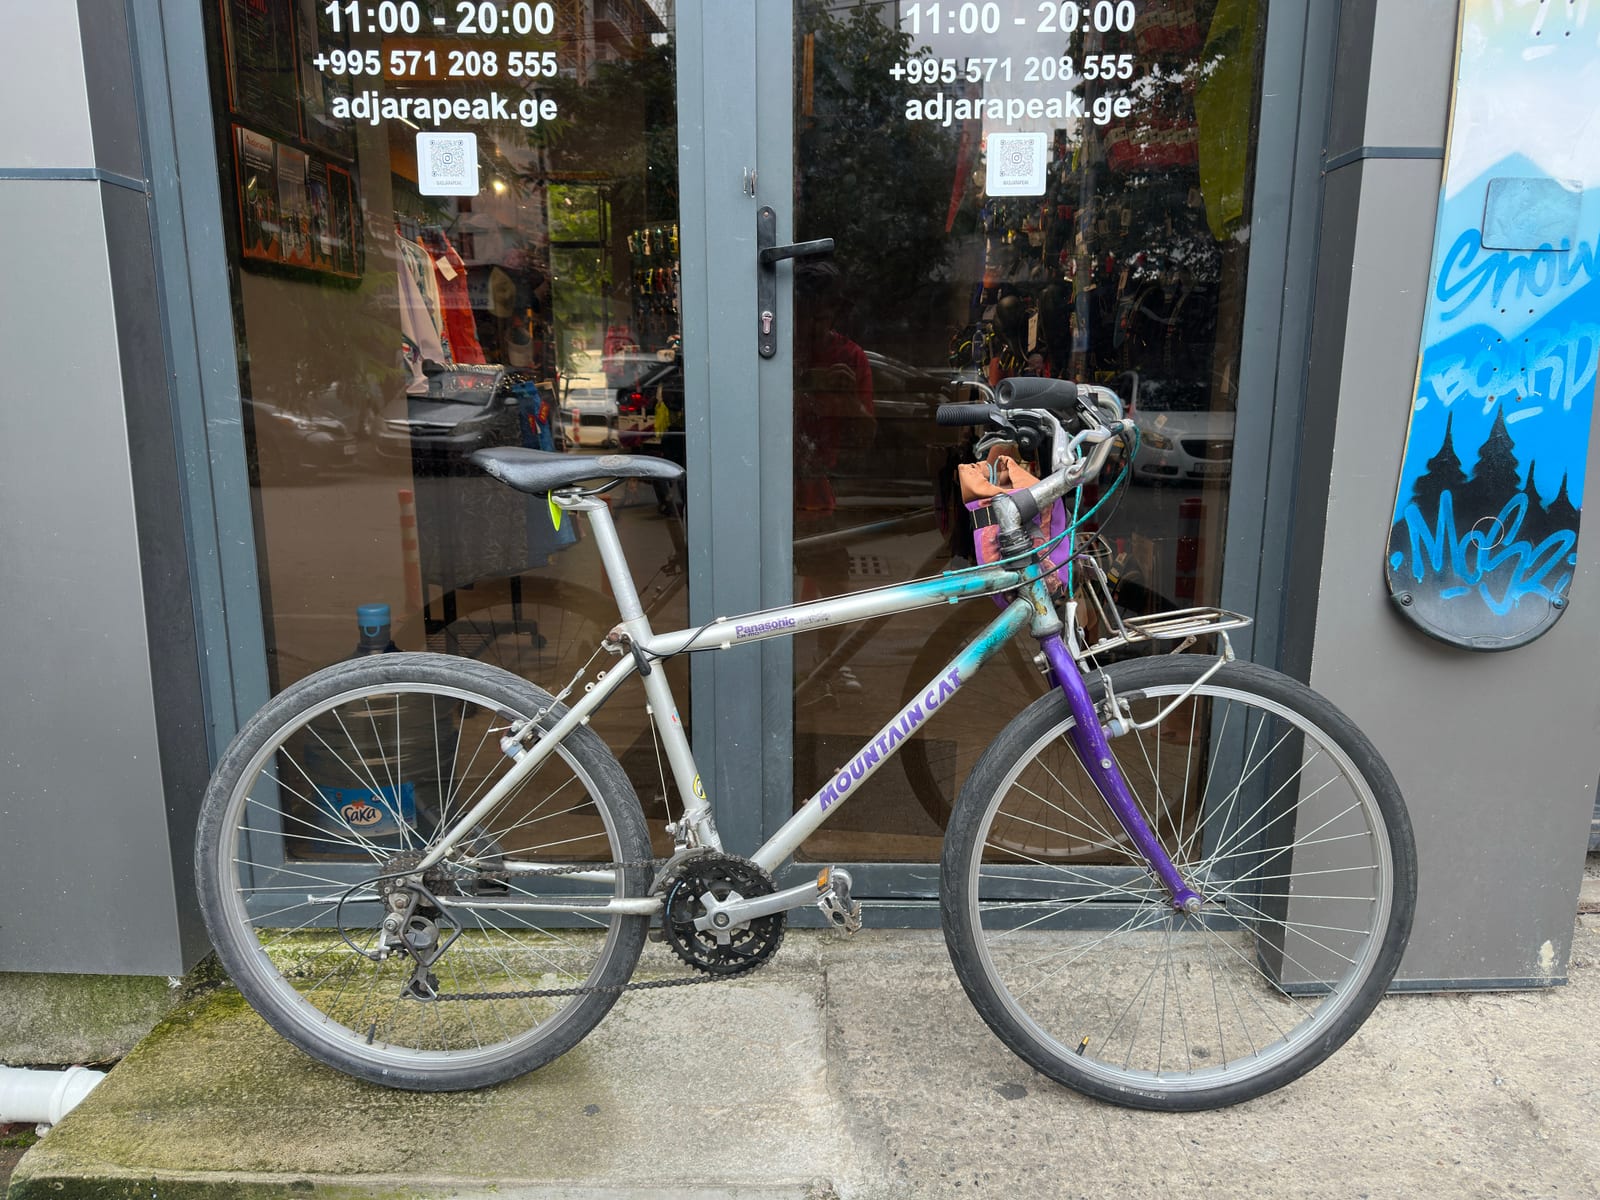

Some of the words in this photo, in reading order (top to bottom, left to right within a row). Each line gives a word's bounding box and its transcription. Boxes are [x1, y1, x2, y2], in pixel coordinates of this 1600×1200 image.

[325, 0, 420, 34] 11:00
[456, 1, 555, 35] 20:00
[906, 1, 1001, 34] 11:00
[1036, 0, 1136, 33] 20:00
[312, 49, 381, 76] +995
[390, 50, 436, 76] 571
[448, 51, 498, 77] 208
[507, 51, 558, 78] 555
[889, 57, 957, 84] +995
[966, 57, 1012, 83] 571
[1024, 56, 1073, 81] 208
[1083, 54, 1133, 80] 555
[332, 91, 558, 127] adjarapeak.ge
[905, 91, 1131, 126] adjarapeak.ge
[735, 617, 796, 634] Panasonic
[819, 703, 924, 811] MOUNTAIN
[924, 667, 962, 711] CAT
[344, 807, 376, 824] Saka
